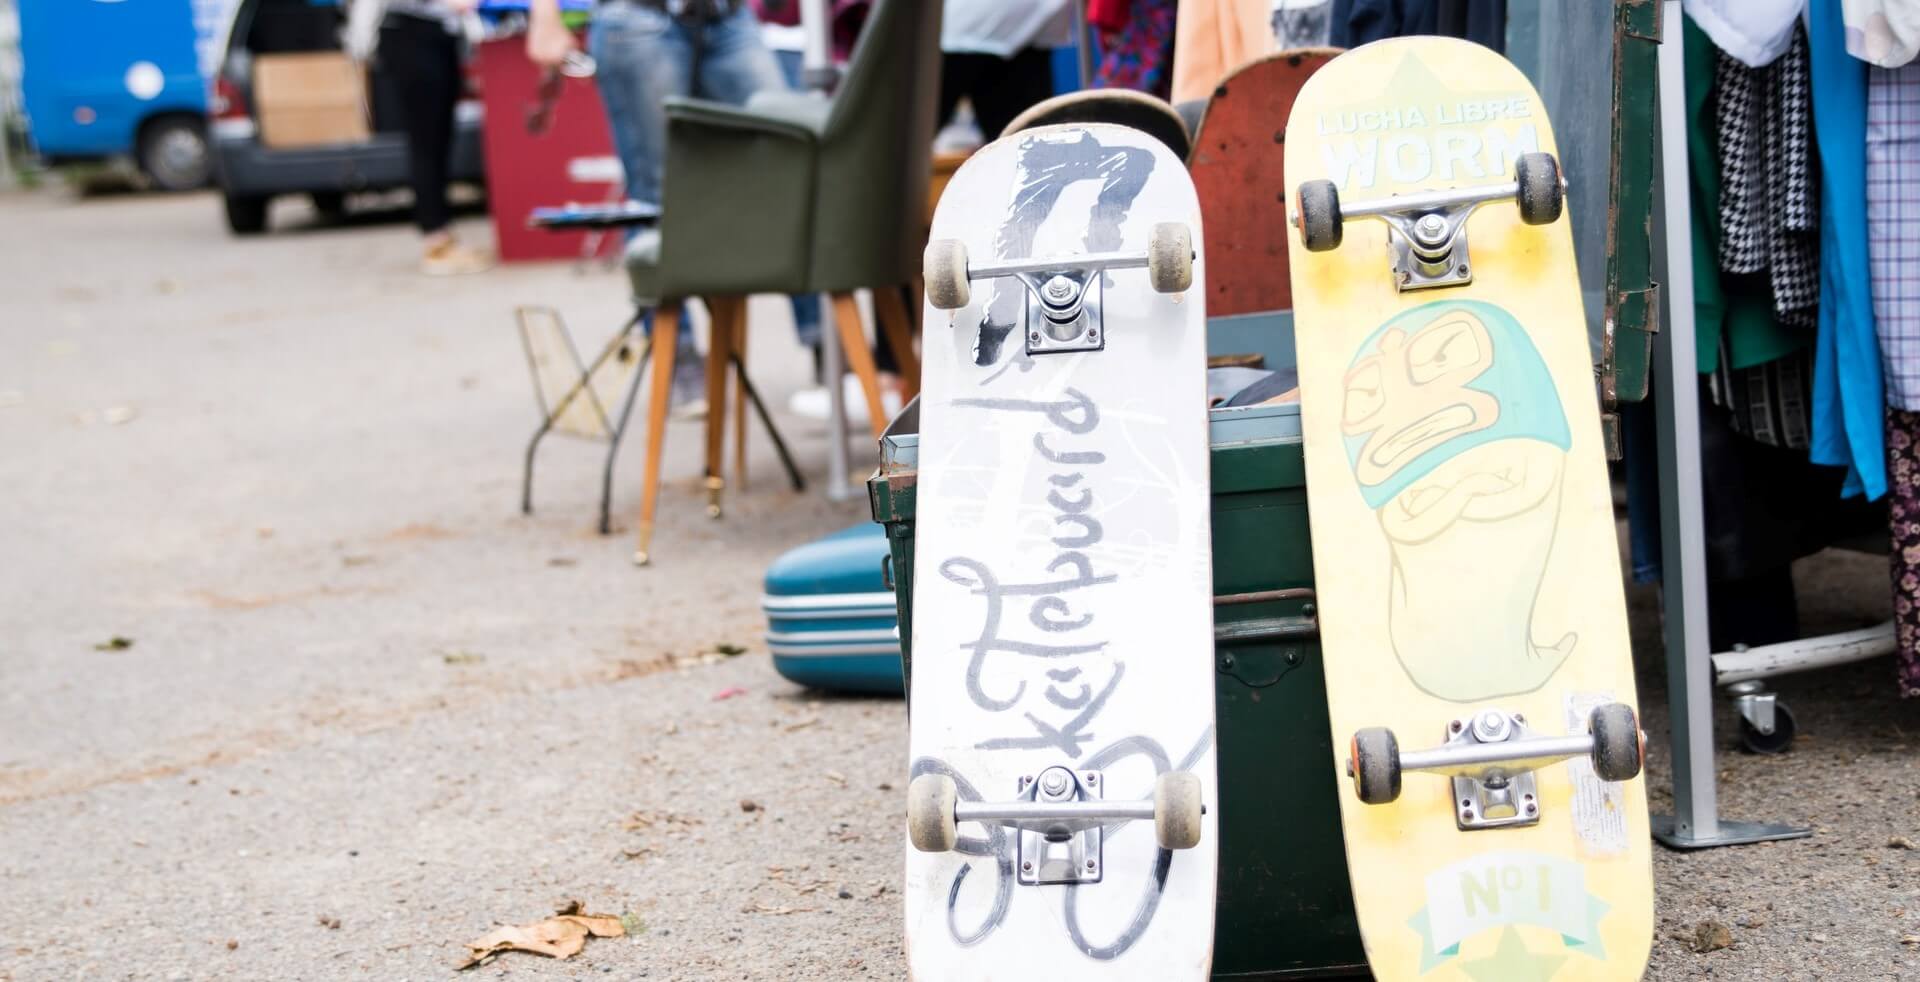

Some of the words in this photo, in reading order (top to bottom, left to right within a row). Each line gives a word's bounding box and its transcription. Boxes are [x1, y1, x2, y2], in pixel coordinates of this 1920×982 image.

[1317, 107, 1427, 136] LUCHA
[1437, 99, 1531, 124] LIBRE
[1320, 123, 1539, 191] WORM
